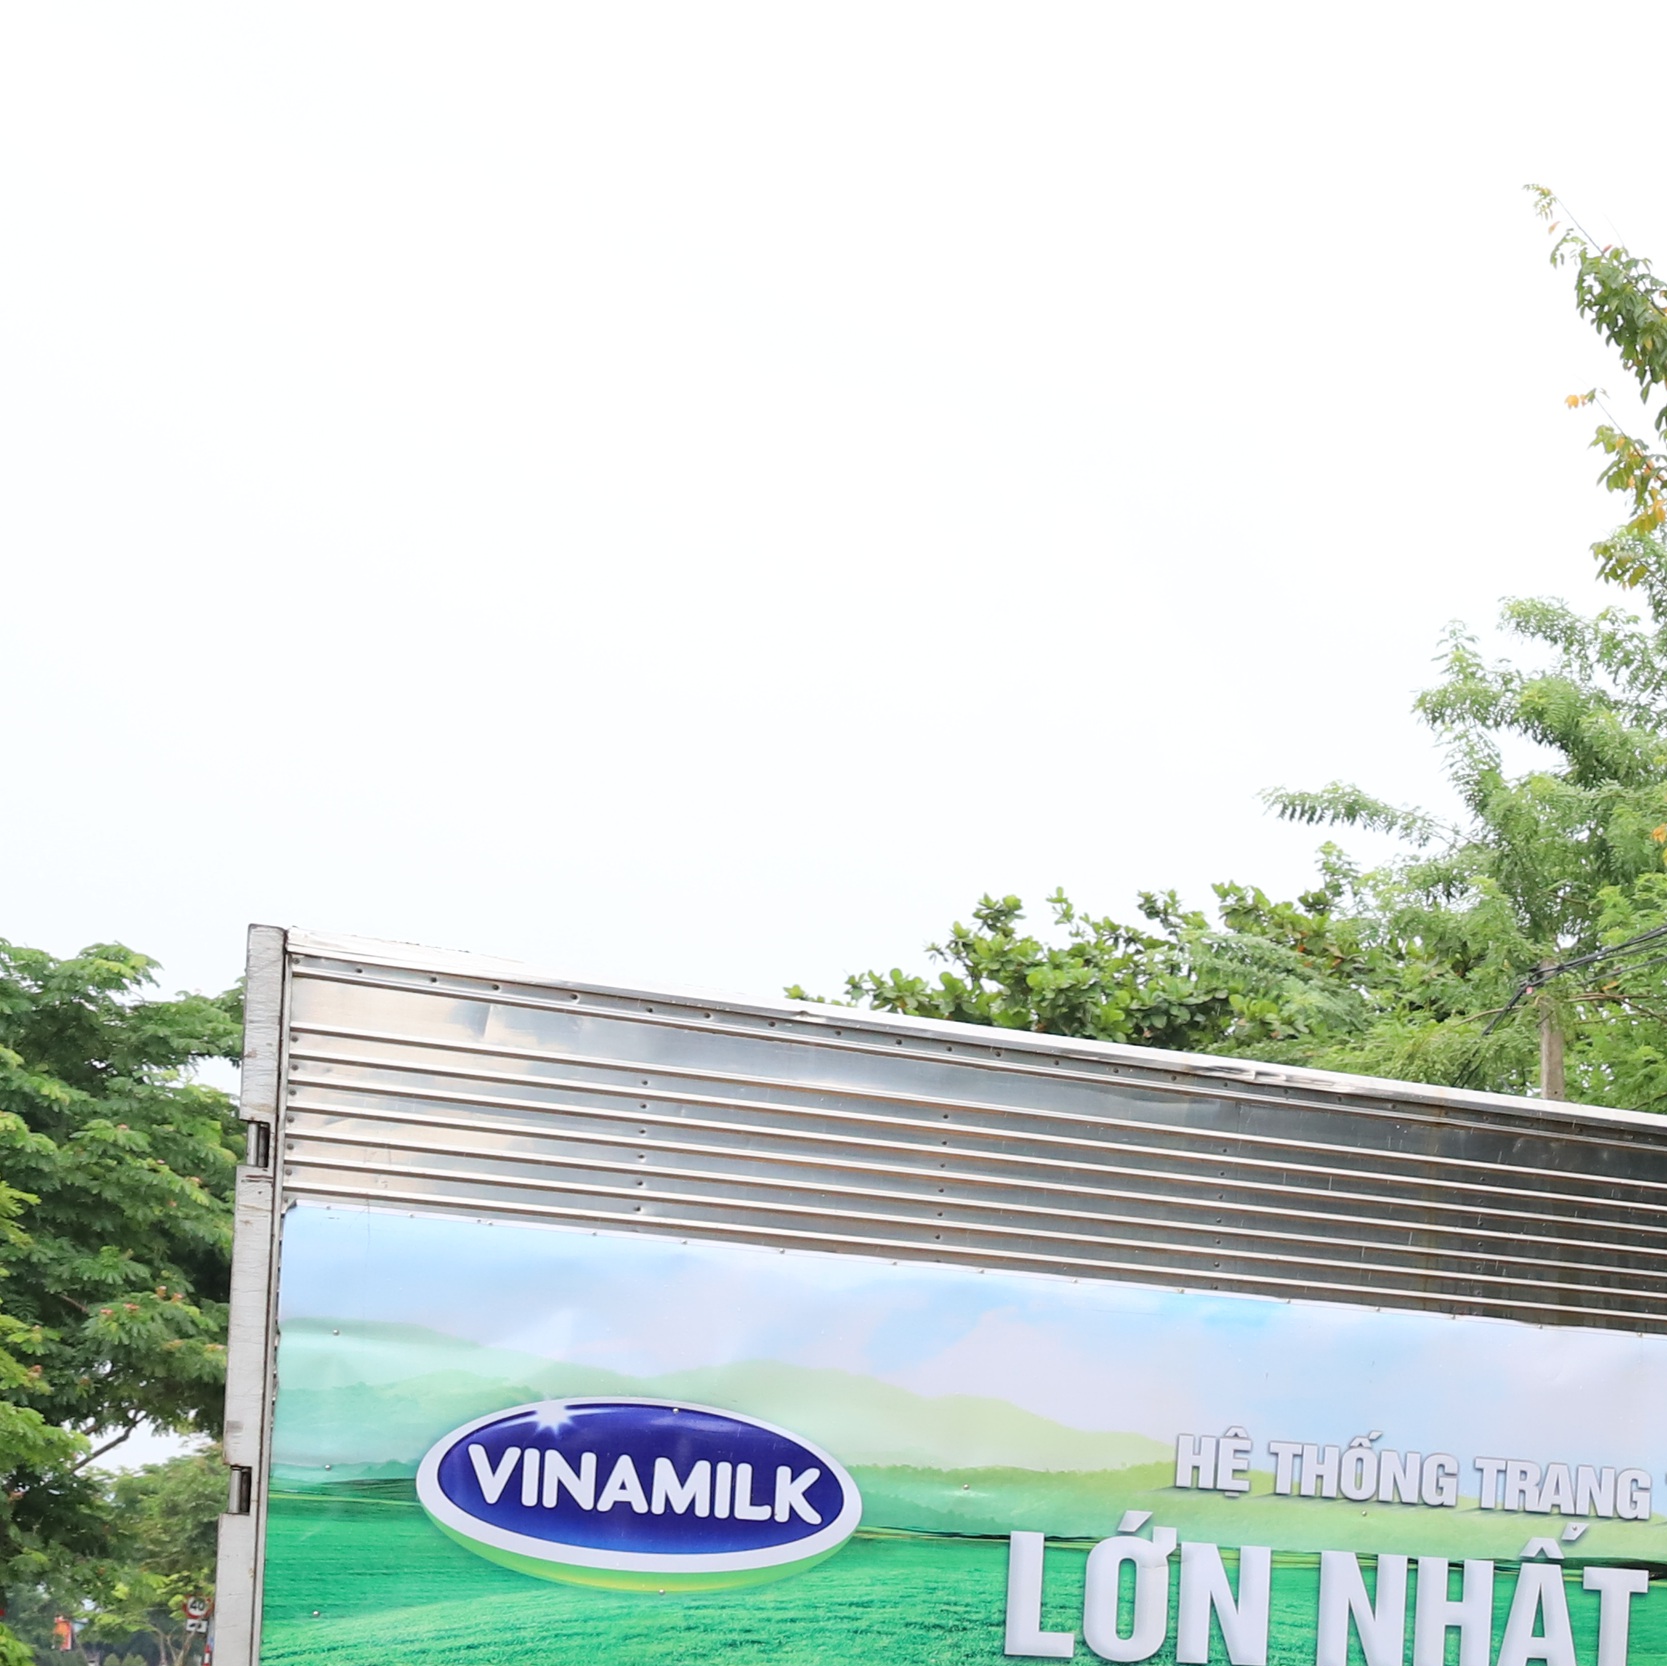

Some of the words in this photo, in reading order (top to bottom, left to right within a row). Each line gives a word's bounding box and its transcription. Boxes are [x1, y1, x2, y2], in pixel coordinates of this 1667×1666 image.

[467, 1443, 823, 1525] VINAMILK
[1175, 1426, 1252, 1498] HỆ
[1269, 1430, 1459, 1507] THỐNG
[1475, 1456, 1652, 1522] TRANG
